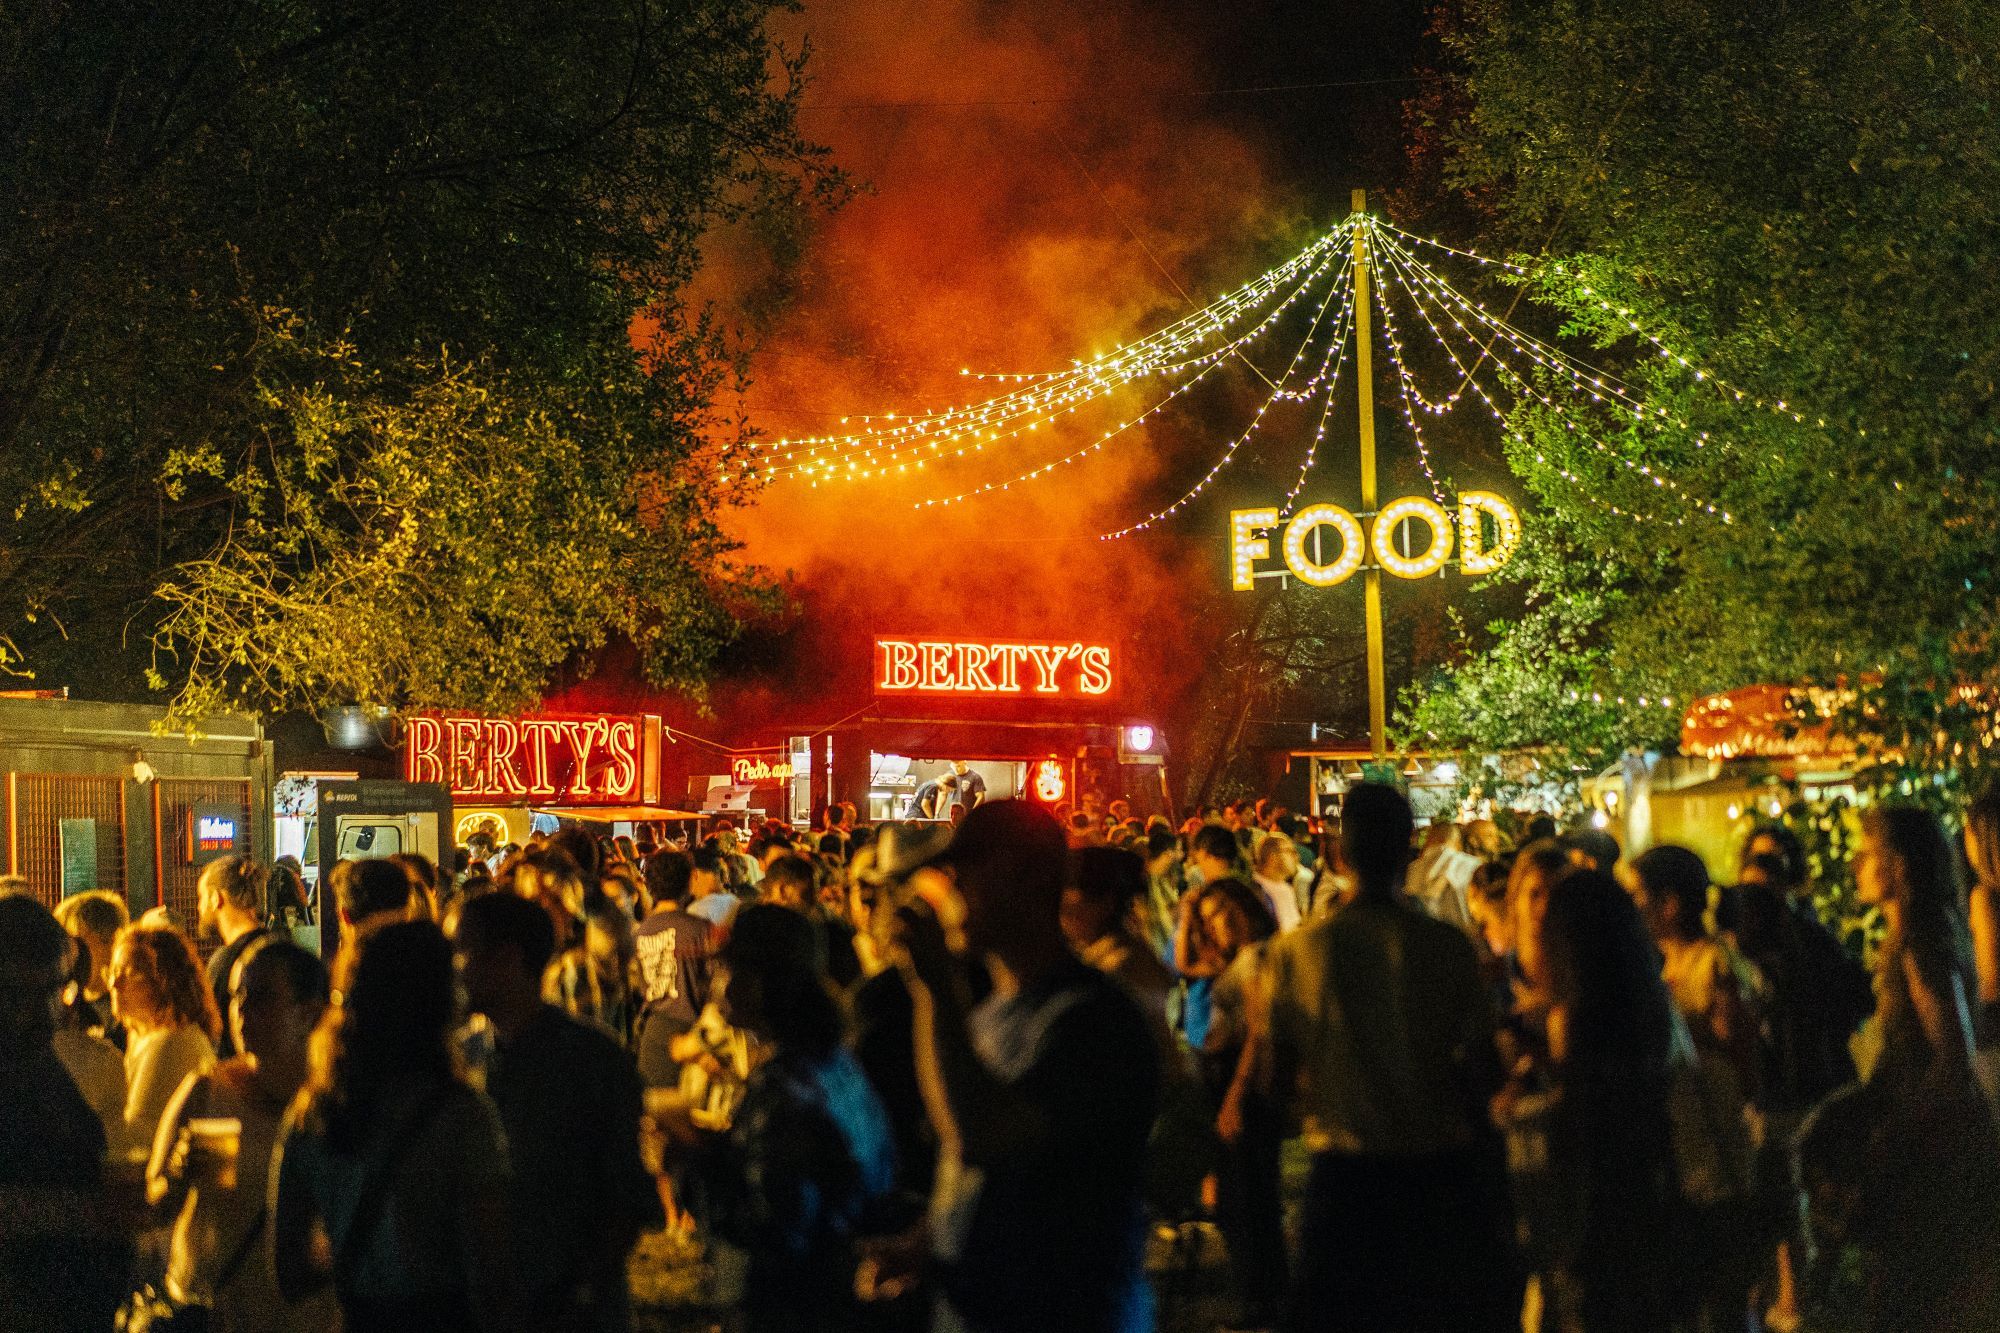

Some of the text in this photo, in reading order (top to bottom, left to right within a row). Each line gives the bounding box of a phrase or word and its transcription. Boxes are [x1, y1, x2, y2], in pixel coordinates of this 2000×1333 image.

[1230, 490, 1521, 591] FOOD
[877, 641, 1112, 694] BERTY'S
[407, 717, 635, 796] BERTY'S
[772, 763, 796, 786] aqu
